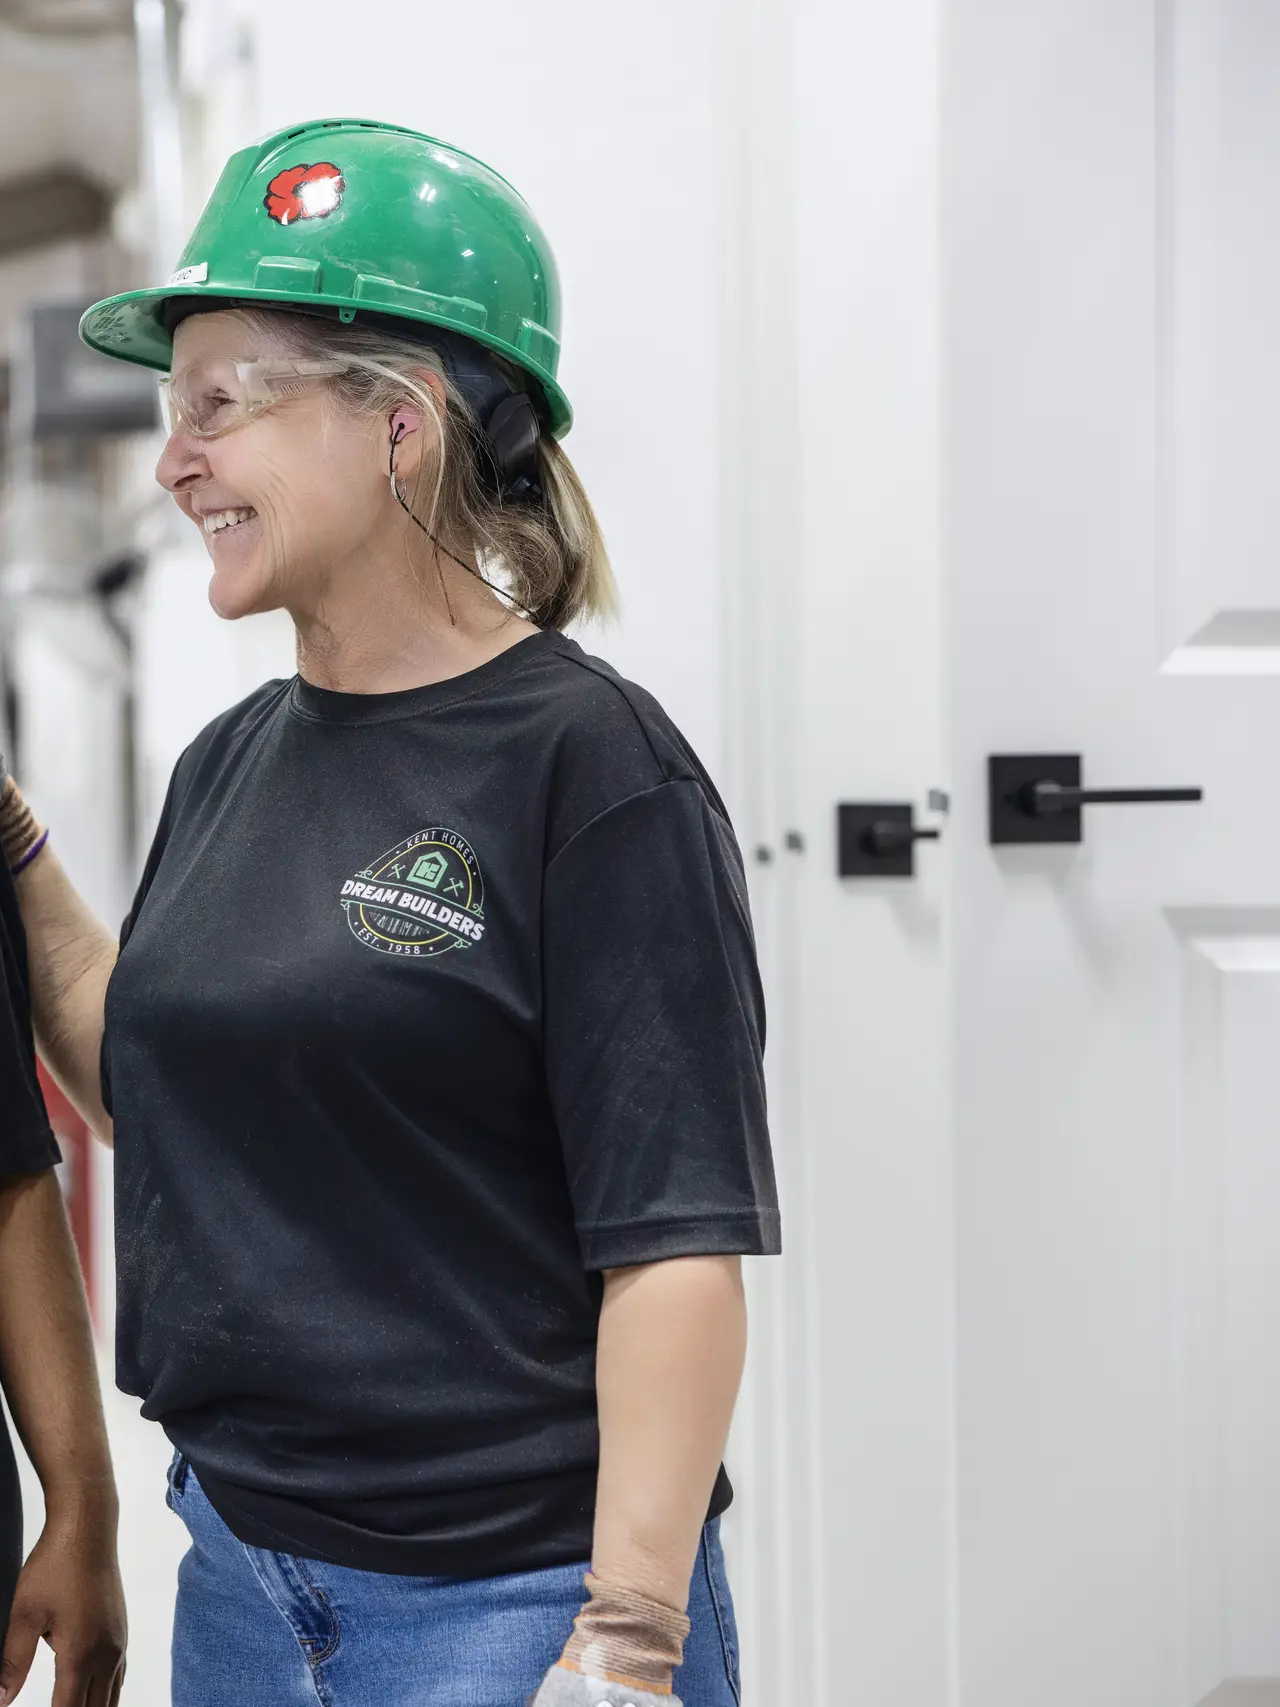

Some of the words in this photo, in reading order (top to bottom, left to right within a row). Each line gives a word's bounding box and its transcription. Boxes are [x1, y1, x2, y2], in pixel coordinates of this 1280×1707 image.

[406, 830, 437, 848] KENT
[441, 832, 474, 865] HOMES
[340, 880, 400, 905] DREAM
[397, 893, 486, 941] BUILDERS
[357, 927, 380, 948] EST.
[388, 942, 422, 955] 1958
